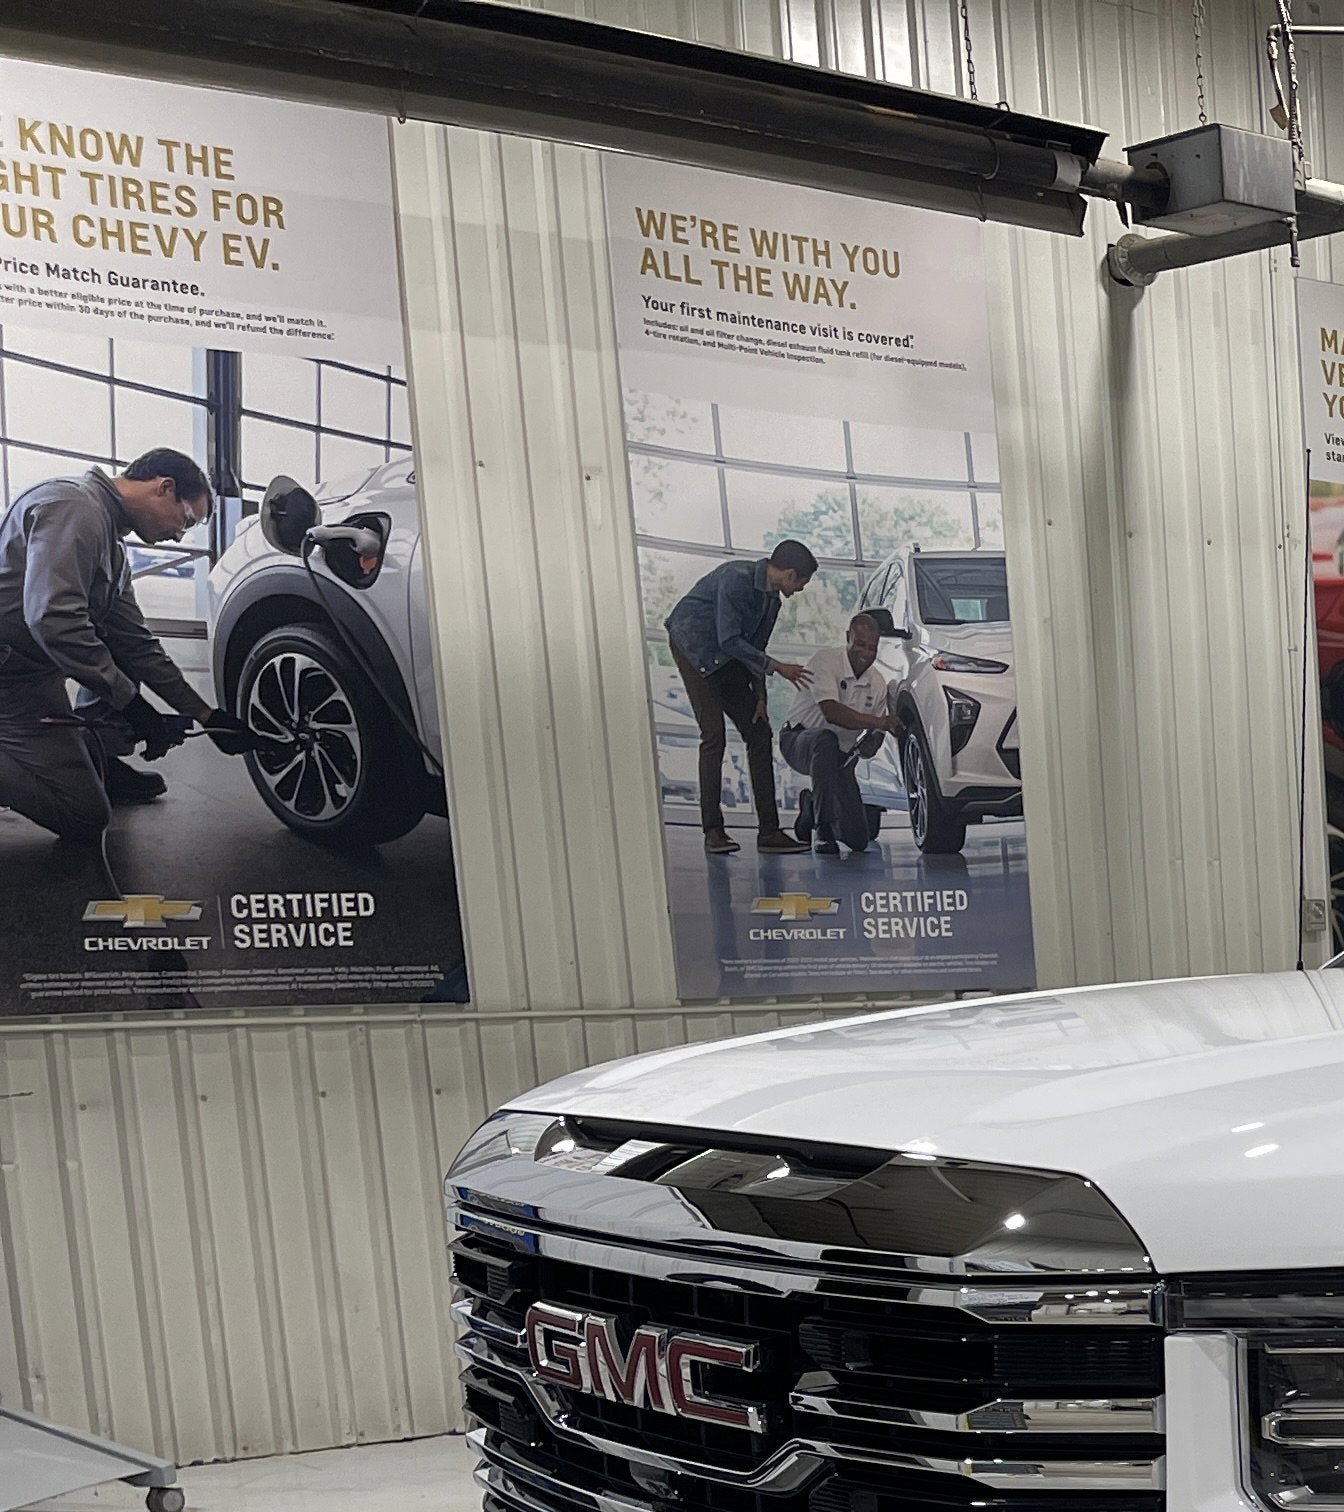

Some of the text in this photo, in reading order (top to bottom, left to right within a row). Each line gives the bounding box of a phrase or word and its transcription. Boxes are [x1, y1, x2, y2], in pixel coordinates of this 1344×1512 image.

[18, 117, 144, 167] KNOW
[157, 139, 235, 181] THE
[79, 170, 198, 218] TIRES
[212, 189, 286, 230] FOR
[72, 214, 208, 262] CHEVY
[222, 233, 280, 271] EV.
[634, 206, 901, 279] WE'RE WITH YOU
[45, 262, 102, 285] Match
[107, 271, 206, 296] Guarantee.
[640, 247, 857, 310] ALL THE WAY.
[18, 298, 42, 308] price
[45, 301, 76, 312] within
[78, 305, 91, 314] 30
[93, 306, 115, 318] days
[117, 310, 127, 318] of
[129, 311, 145, 320] the
[195, 320, 211, 328] and
[236, 323, 267, 334] refund
[269, 327, 284, 336] the
[29, 287, 35, 295] a
[37, 287, 69, 298] better
[108, 297, 132, 306] price
[134, 300, 144, 308] at
[146, 301, 162, 310] the
[164, 303, 185, 313] time
[187, 305, 197, 314] of
[246, 313, 262, 322] and
[287, 317, 315, 327] match
[641, 294, 676, 313] Your
[679, 301, 712, 320] first
[716, 310, 806, 334] maintenance
[809, 323, 839, 340] visit
[842, 326, 854, 341] is
[230, 892, 375, 919] CERTIFIED
[860, 889, 969, 914] CERTIFIED
[84, 936, 211, 951] CHEVROLET
[233, 922, 354, 949] SERVICE
[749, 928, 847, 941] CHEVROLET
[863, 915, 953, 939] SERVICE
[525, 1300, 767, 1434] GMC
